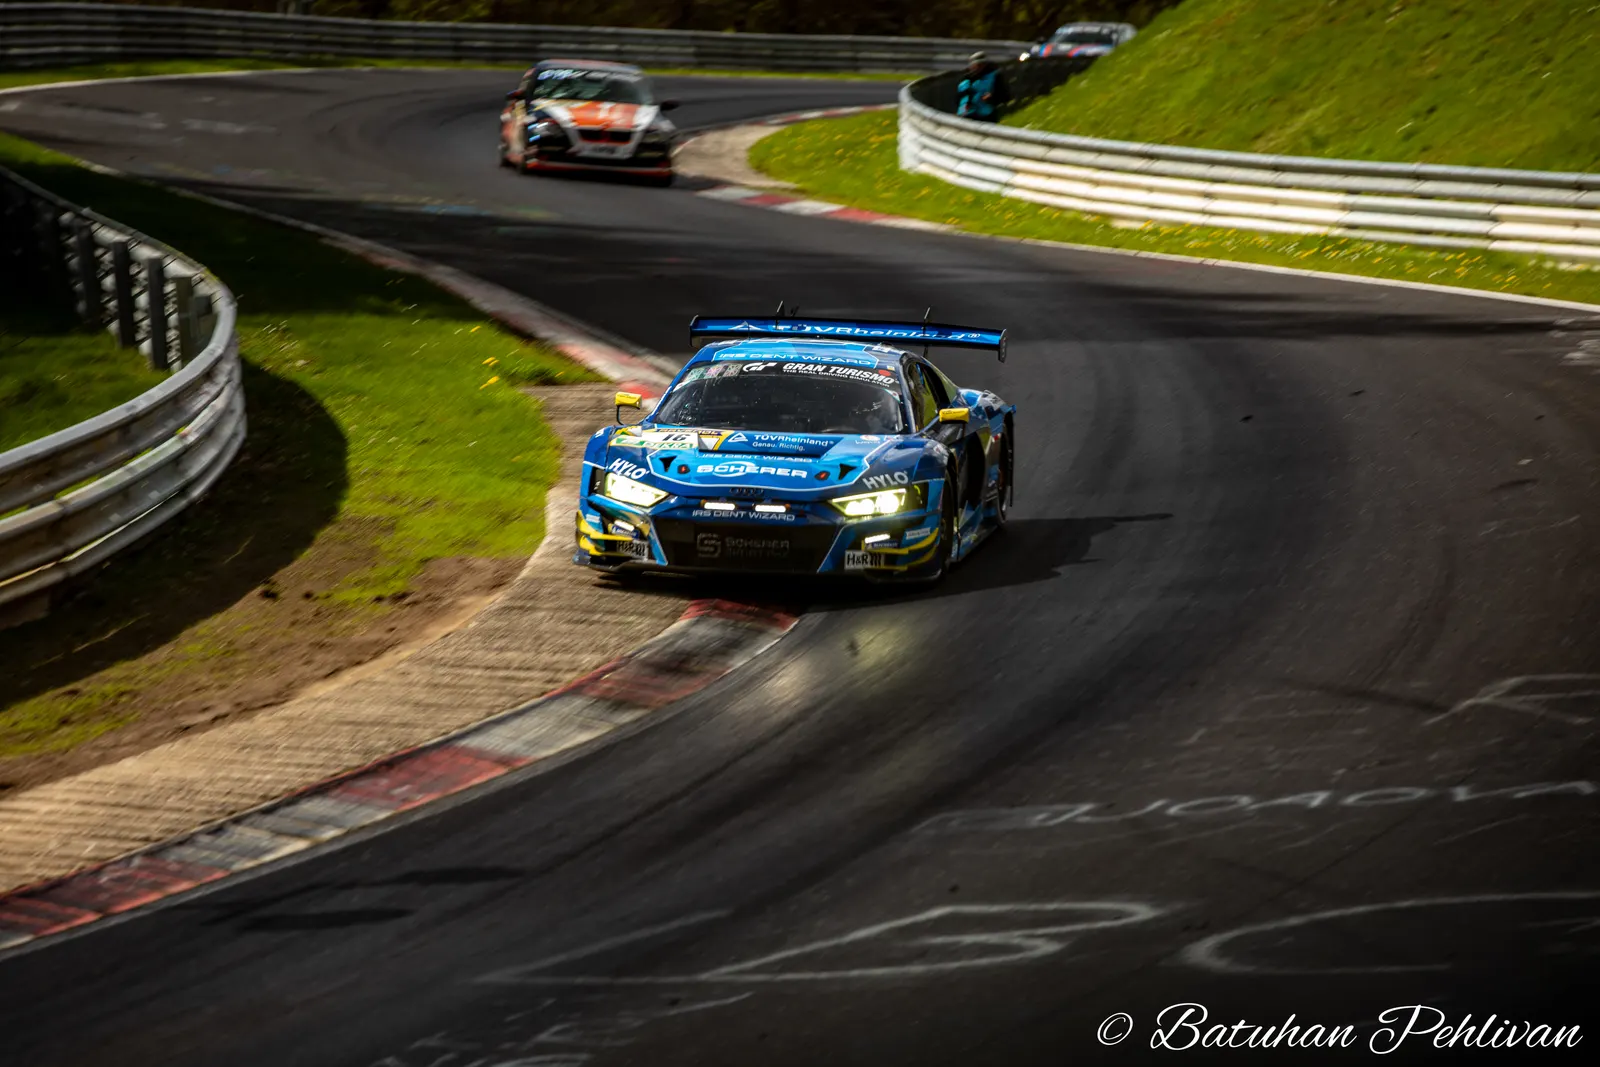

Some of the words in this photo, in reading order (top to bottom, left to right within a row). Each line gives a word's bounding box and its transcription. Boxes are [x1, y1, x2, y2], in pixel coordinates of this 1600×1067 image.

[802, 356, 871, 365] WIZARD
[783, 362, 824, 373] GRAN
[829, 366, 895, 385] TURISMO
[849, 375, 890, 388] SIMULATOR
[662, 433, 691, 442] 16
[779, 442, 806, 452] Richtig.
[762, 455, 813, 463] WIZARD
[608, 457, 648, 480] HYLO
[696, 464, 808, 479] SCHERER
[862, 471, 909, 490] HYLO
[692, 509, 712, 517] IRS
[713, 510, 746, 519] DENT
[748, 511, 796, 522] WIZARD
